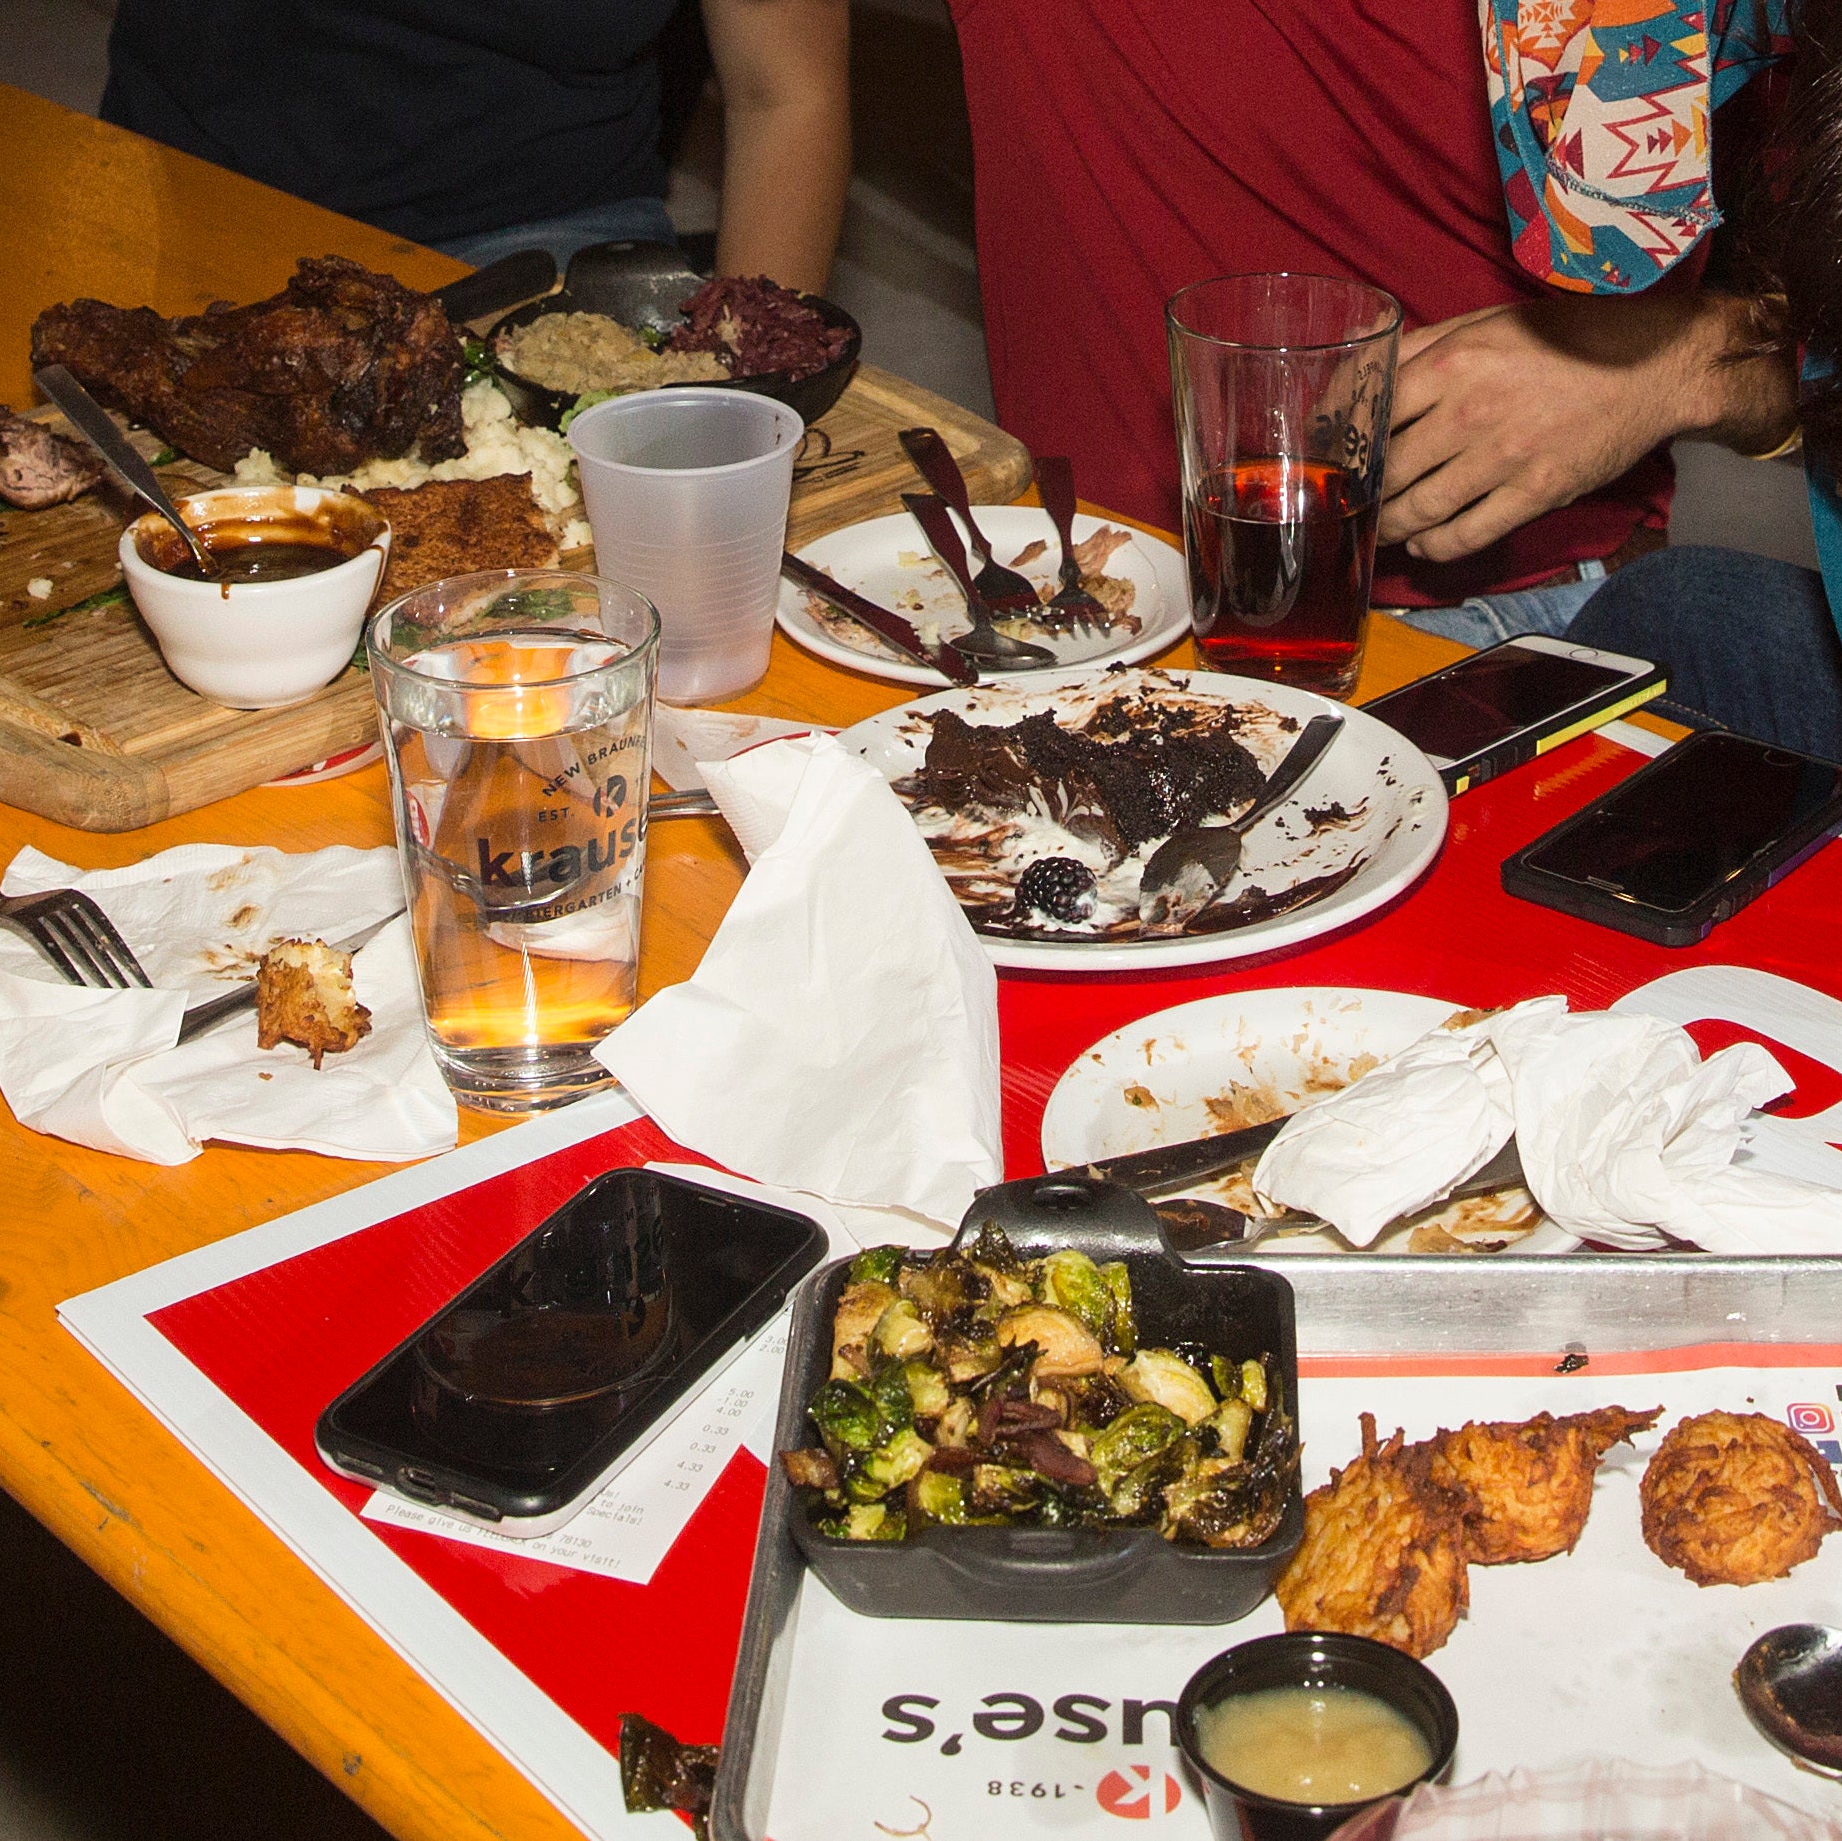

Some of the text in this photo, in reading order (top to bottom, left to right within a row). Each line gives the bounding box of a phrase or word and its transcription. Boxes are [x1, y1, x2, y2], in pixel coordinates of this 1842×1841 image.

[541, 762, 582, 798] NEW
[537, 806, 575, 823] EST.
[759, 1344, 785, 1355] 2.00
[728, 1387, 755, 1399] 5.00
[715, 1405, 742, 1417] 4.00
[702, 1423, 730, 1436] 0.33
[689, 1441, 717, 1454] 0.33
[676, 1460, 704, 1473] 4.33
[663, 1479, 691, 1492] 4.33
[385, 1503, 424, 1522] Please
[426, 1515, 455, 1532] give
[531, 1540, 547, 1552] on
[548, 1544, 578, 1560] your
[581, 1551, 622, 1569] visit!
[881, 1691, 1181, 1757] use's
